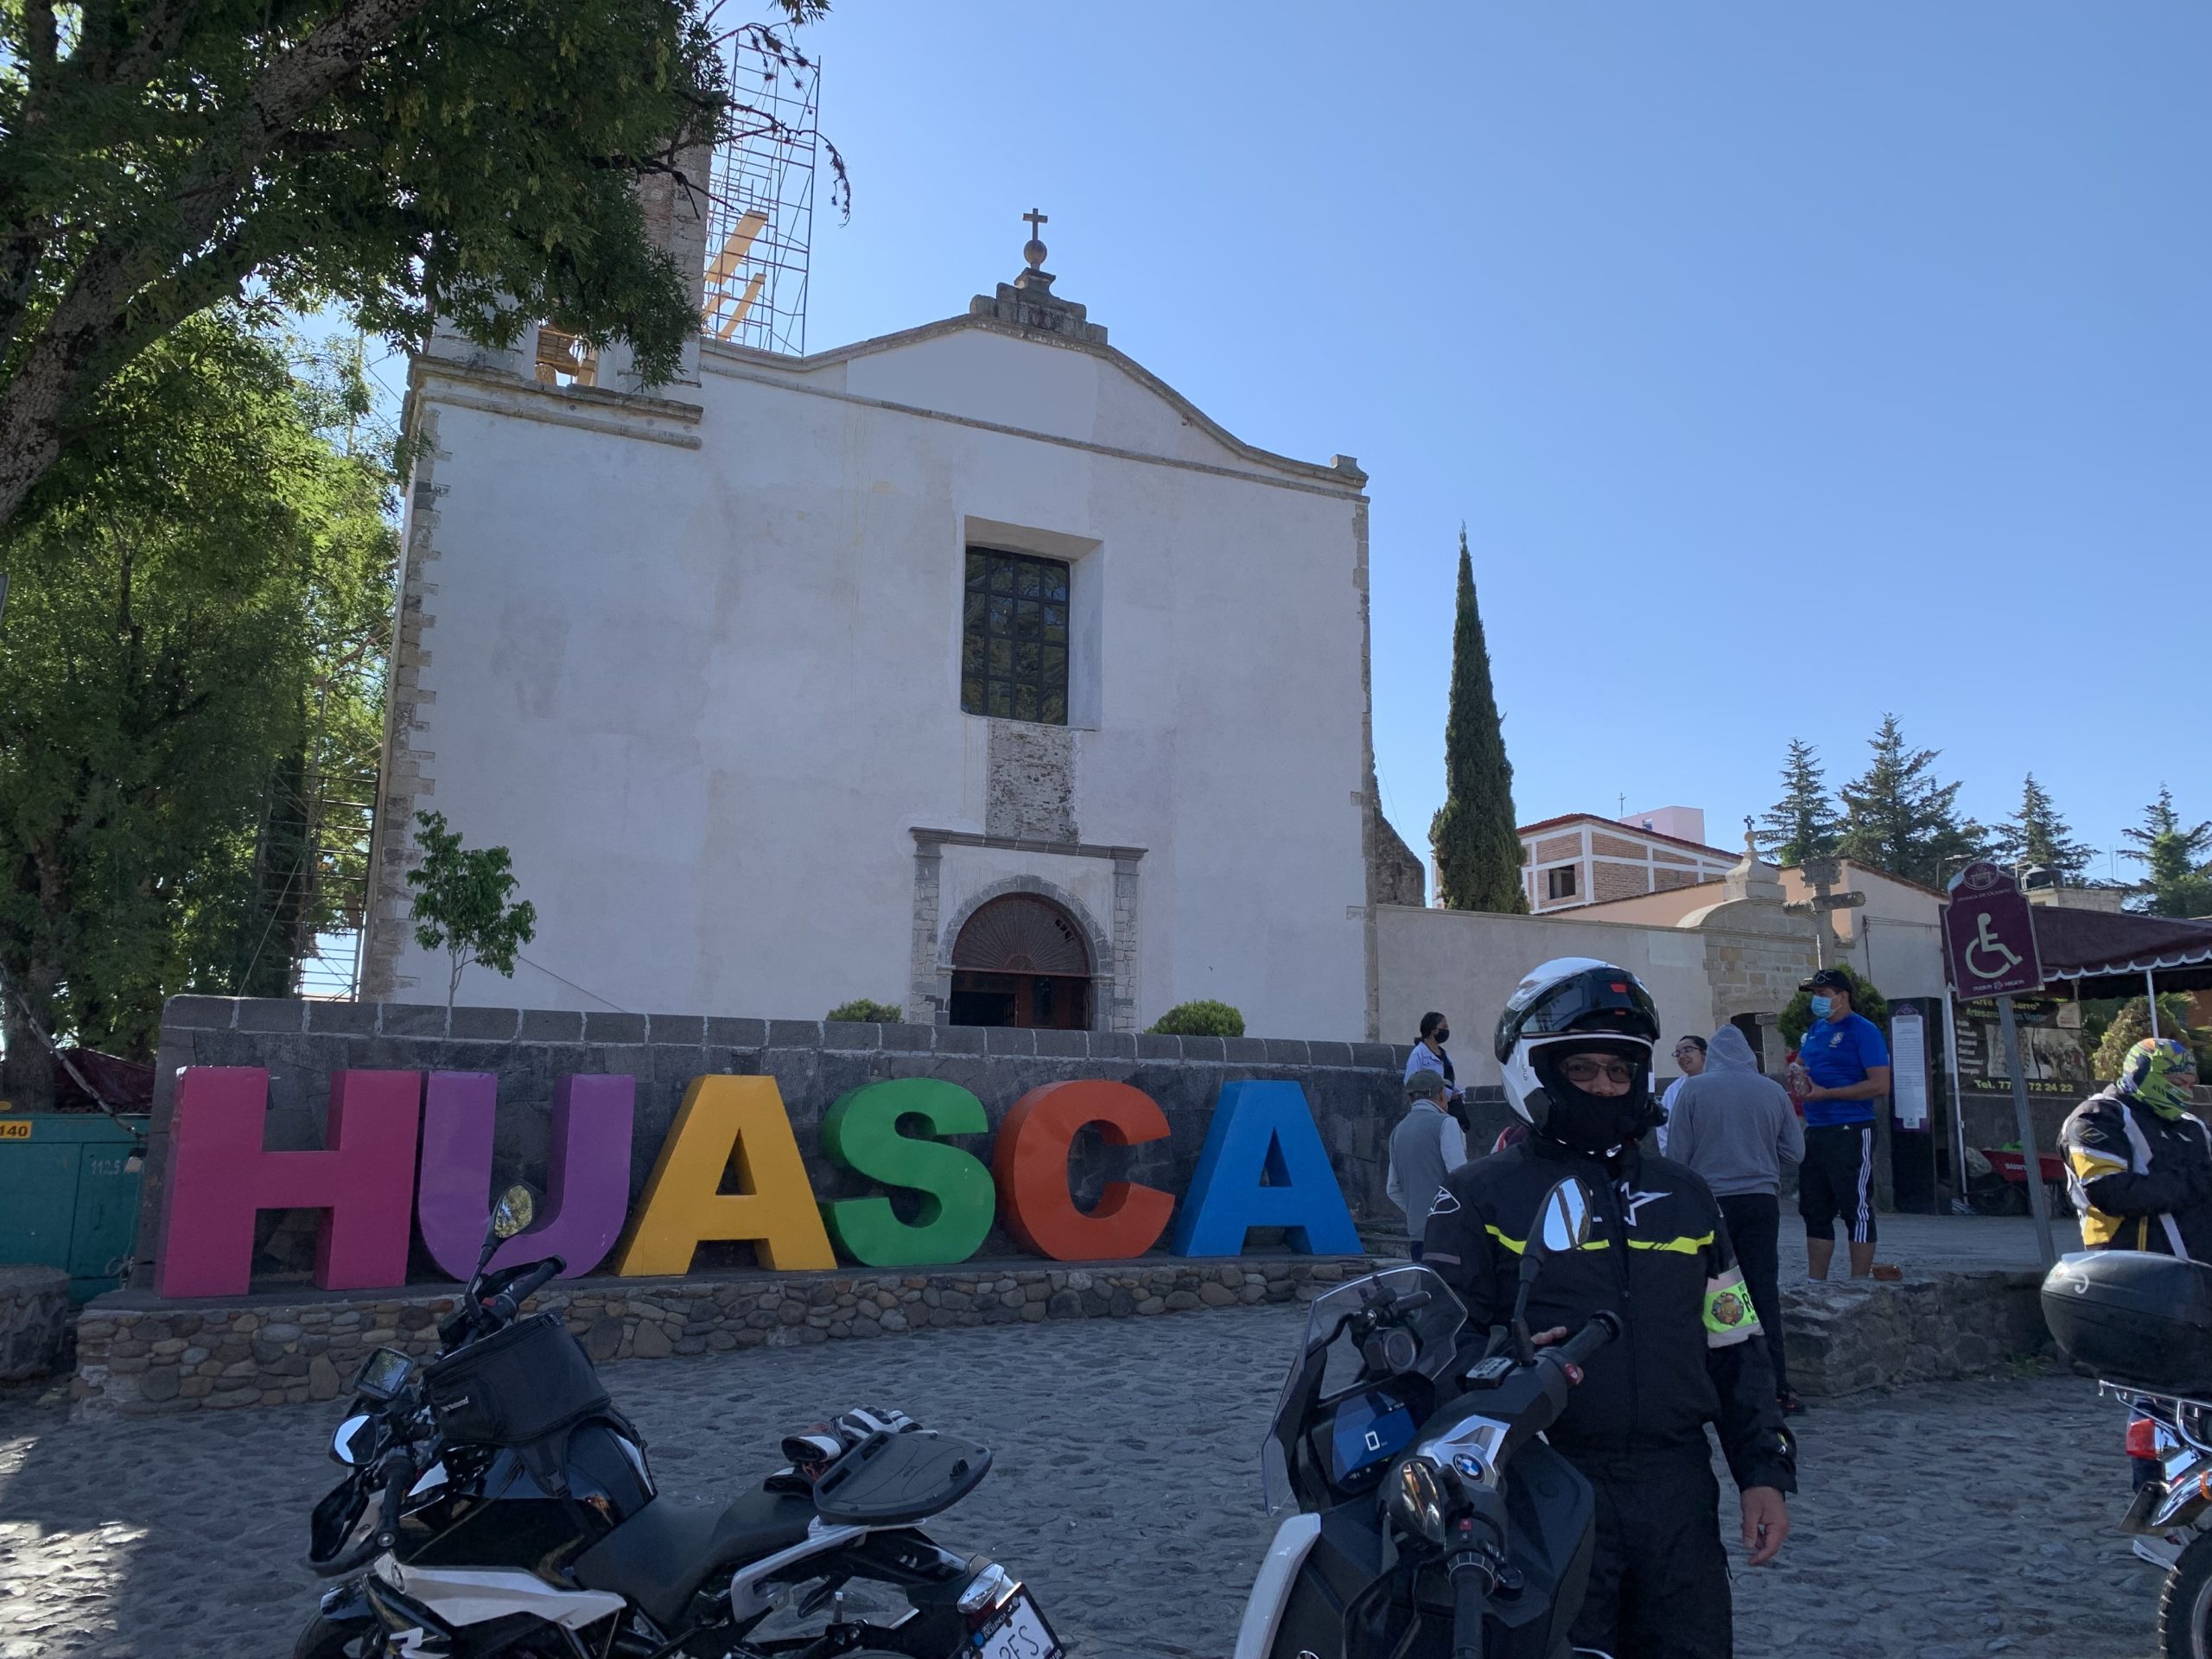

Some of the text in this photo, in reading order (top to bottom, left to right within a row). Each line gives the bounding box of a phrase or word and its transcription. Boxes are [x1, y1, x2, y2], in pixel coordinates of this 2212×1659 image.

[1974, 1079, 1995, 1089] Tel.
[2028, 1082, 2042, 1091] 72
[2044, 1083, 2057, 1092] 24
[2060, 1084, 2074, 1092] 22
[156, 1065, 1363, 1298] HUASCA
